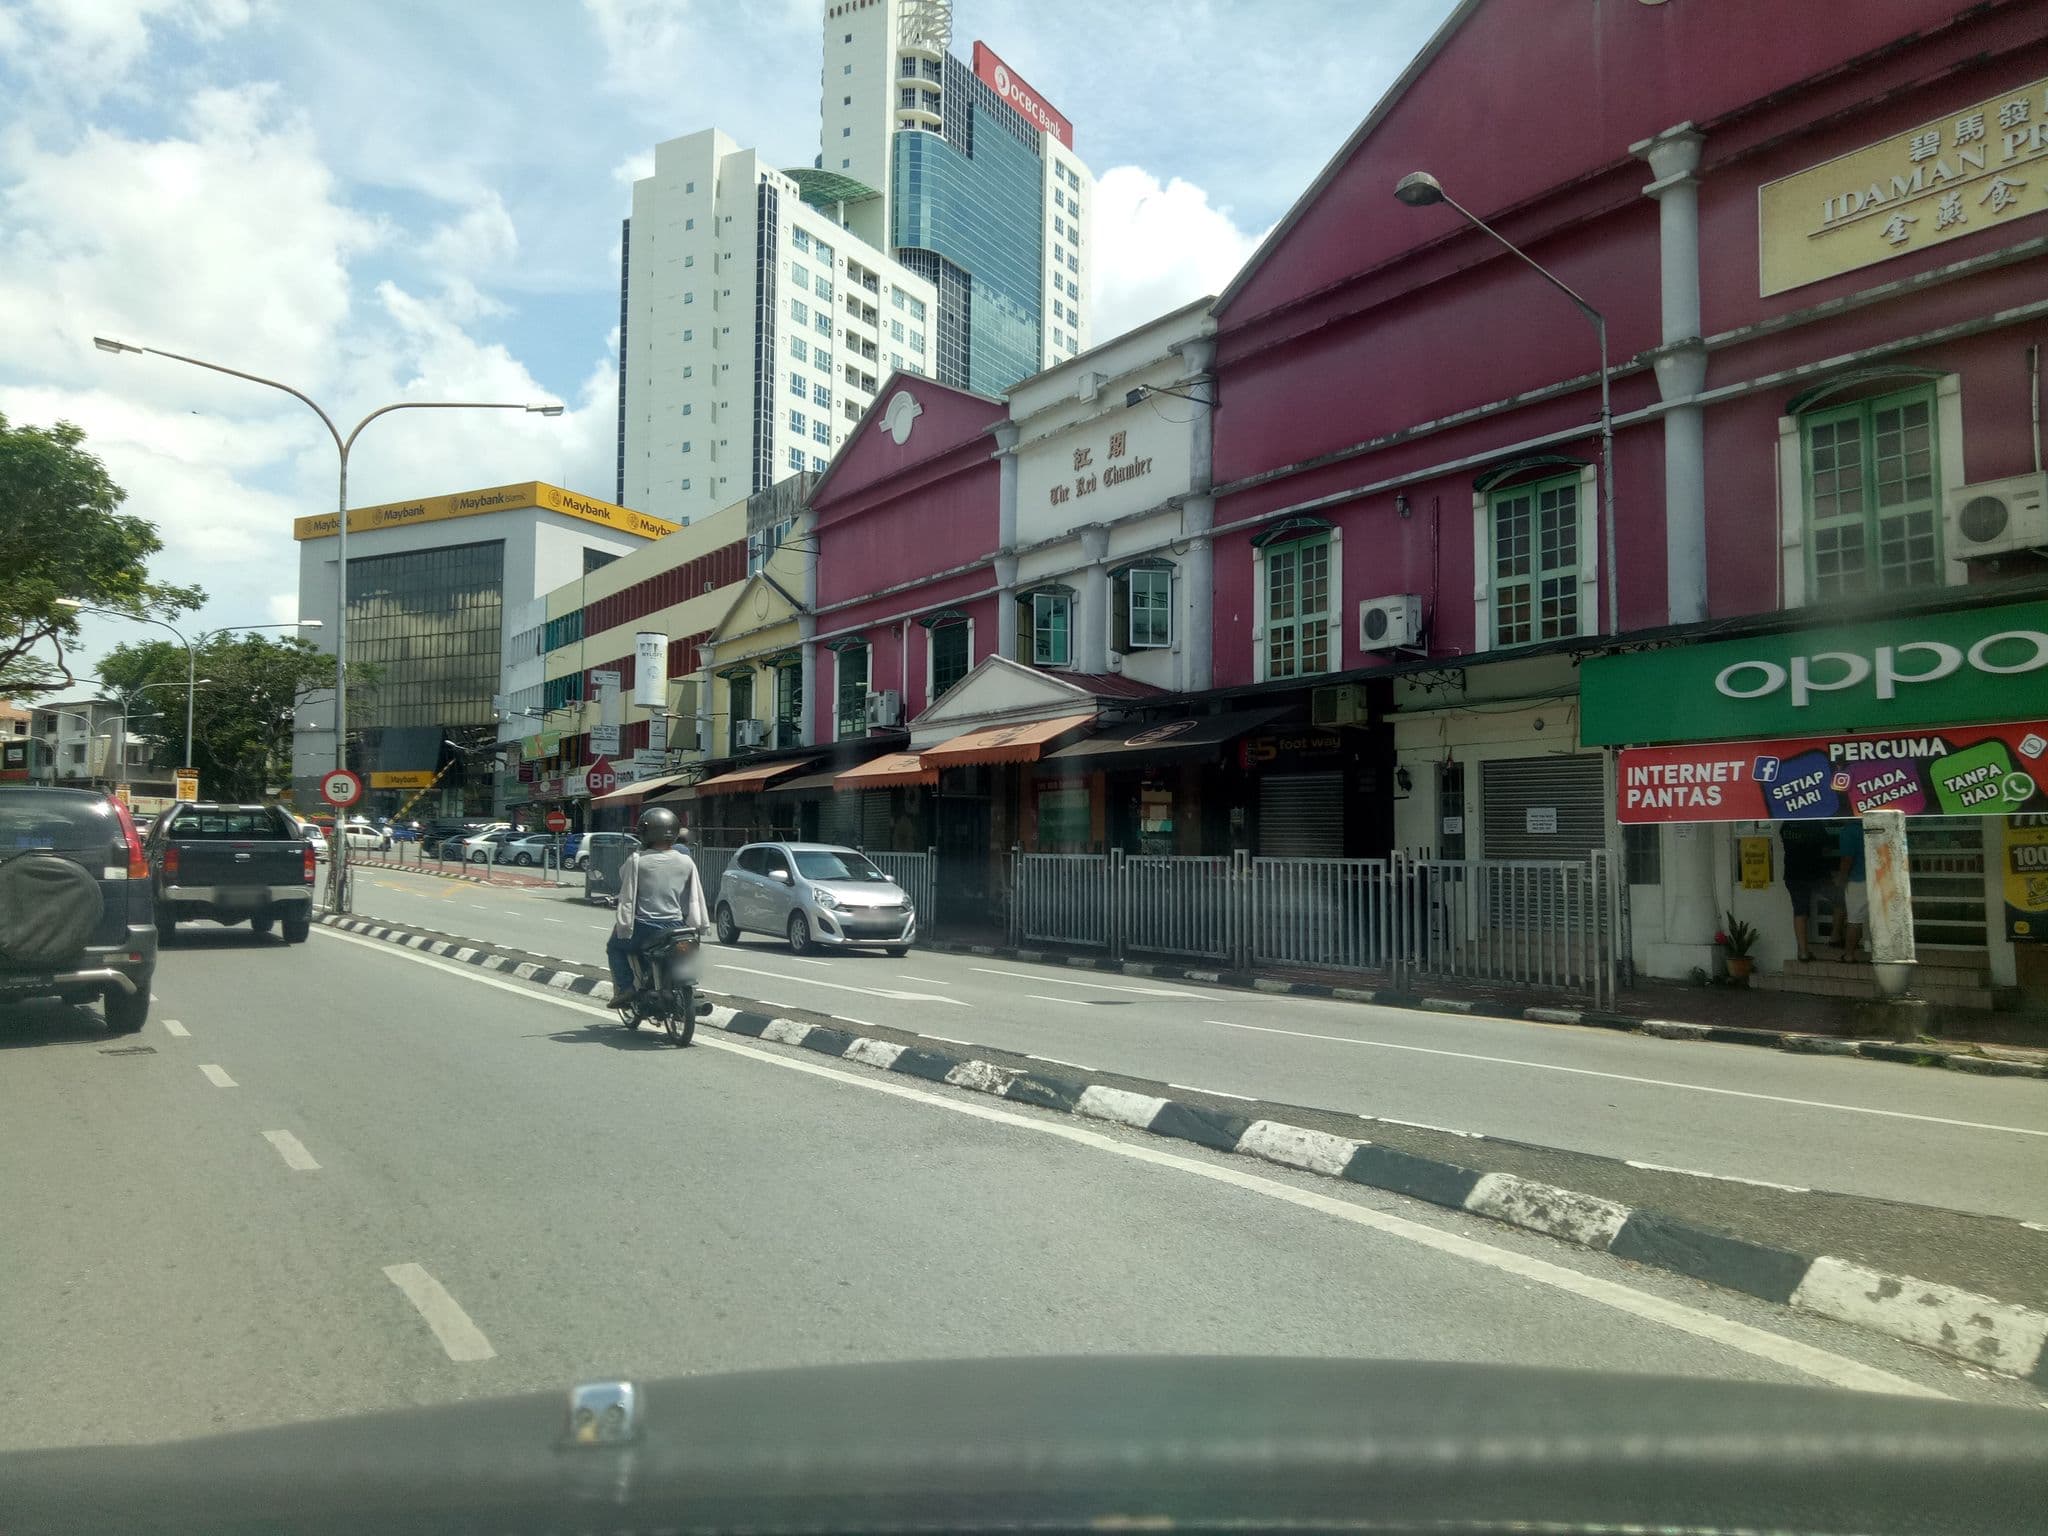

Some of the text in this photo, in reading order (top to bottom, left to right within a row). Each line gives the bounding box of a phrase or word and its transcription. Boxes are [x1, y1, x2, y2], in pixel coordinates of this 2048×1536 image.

[1010, 84, 1061, 140] OCBC Bank
[1908, 90, 2048, 162] 碧馬發
[1823, 143, 1988, 225] IDAMAN
[1050, 456, 1153, 506] The Red Chamber
[384, 504, 425, 521] Maybank
[459, 492, 504, 511] Maybank
[562, 495, 611, 520] Maybank
[313, 516, 353, 532] Maybak
[1829, 737, 1948, 762] PERCUMA
[391, 775, 419, 784] Maybank
[589, 773, 615, 789] BP
[1627, 760, 1746, 787] INTERNET
[1772, 771, 1825, 800] SETIAP
[1857, 769, 1908, 795] TIADA
[1943, 763, 2003, 793] TANPA
[332, 782, 349, 794] 50
[1627, 786, 1723, 809] PANTAS
[1784, 789, 1822, 812] HARI
[1857, 781, 1919, 813] BATASAN
[1960, 783, 1999, 807] HAD
